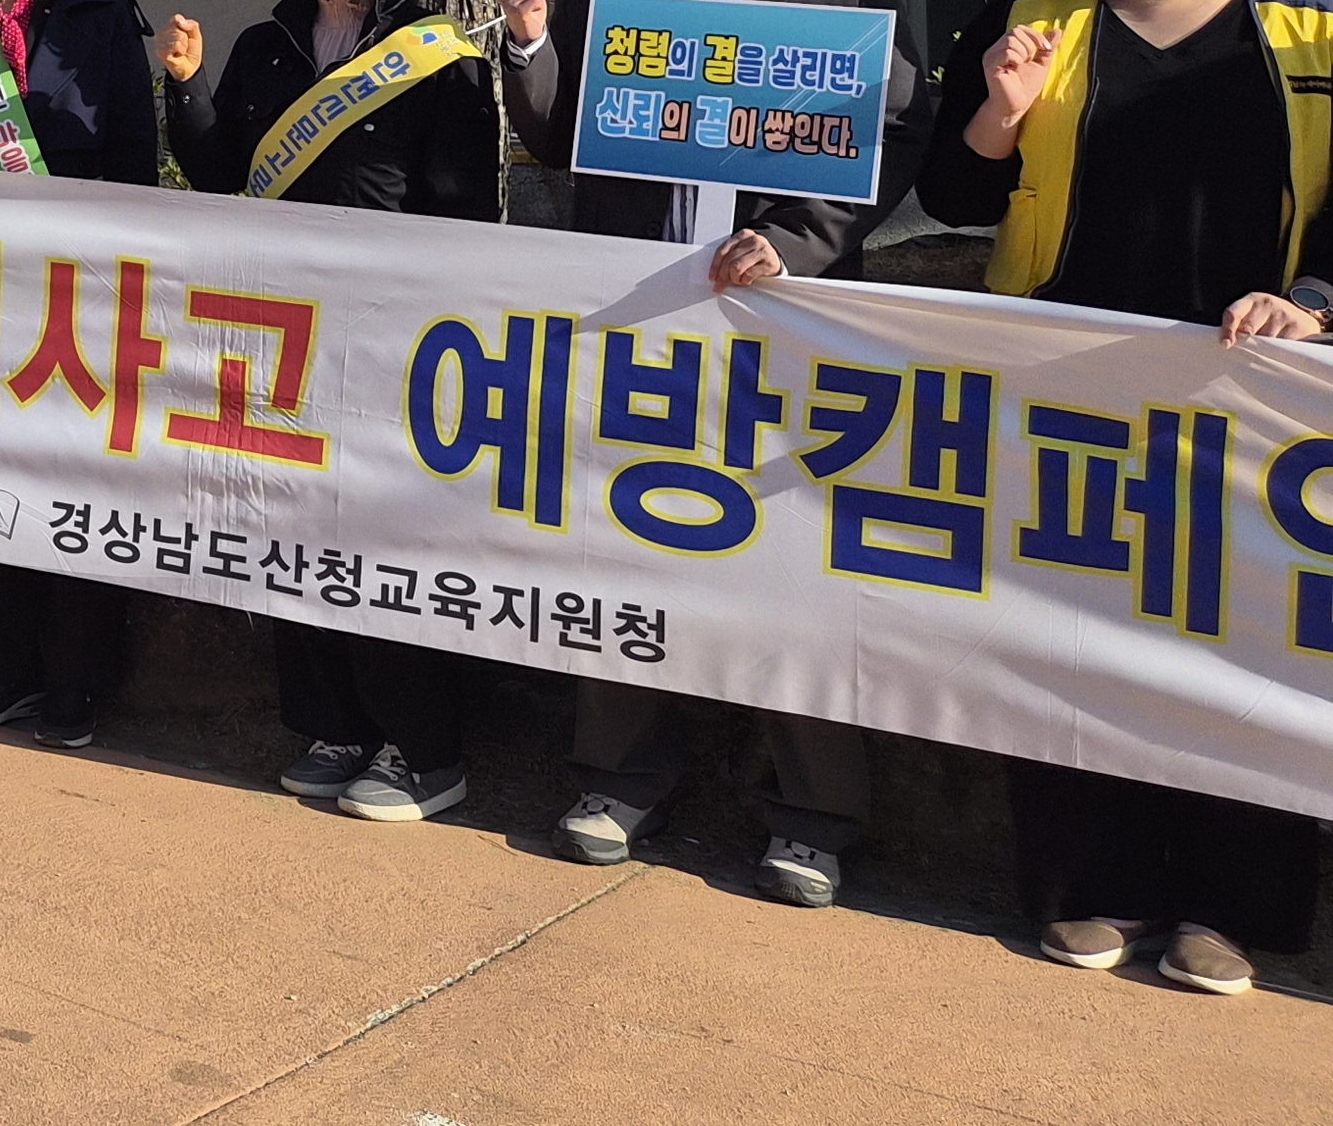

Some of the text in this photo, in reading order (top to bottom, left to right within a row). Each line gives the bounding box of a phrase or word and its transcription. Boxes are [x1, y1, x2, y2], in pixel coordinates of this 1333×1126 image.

[604, 26, 866, 97] 청렴의 결을 살리면,
[596, 88, 859, 158] 신뢰의 결이 쌓인다.
[47, 500, 669, 663] 경상남도산청교육지원청
